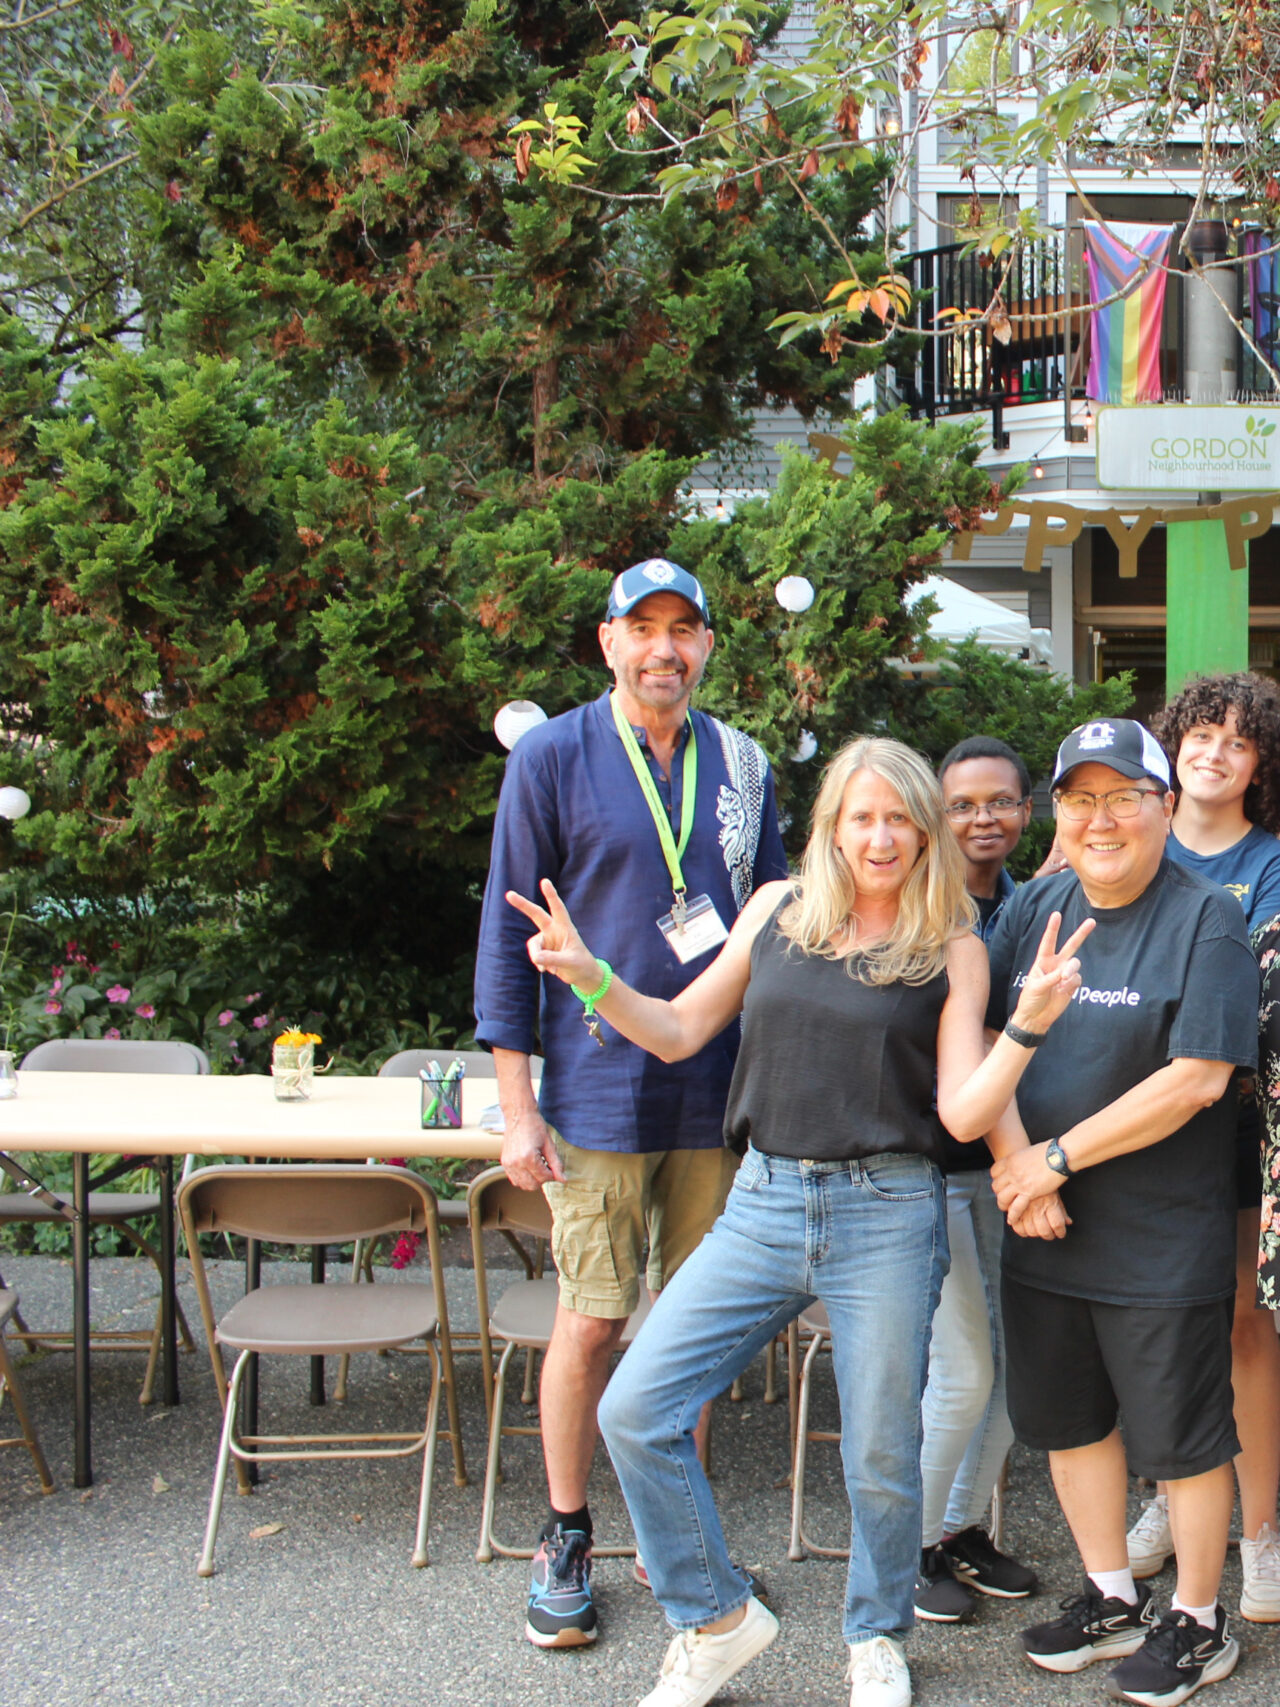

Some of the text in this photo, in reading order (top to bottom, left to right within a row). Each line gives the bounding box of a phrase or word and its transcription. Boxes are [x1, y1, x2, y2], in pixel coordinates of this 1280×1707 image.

[1151, 438, 1267, 459] GORDON
[1148, 459, 1272, 473] Neighbourhood House
